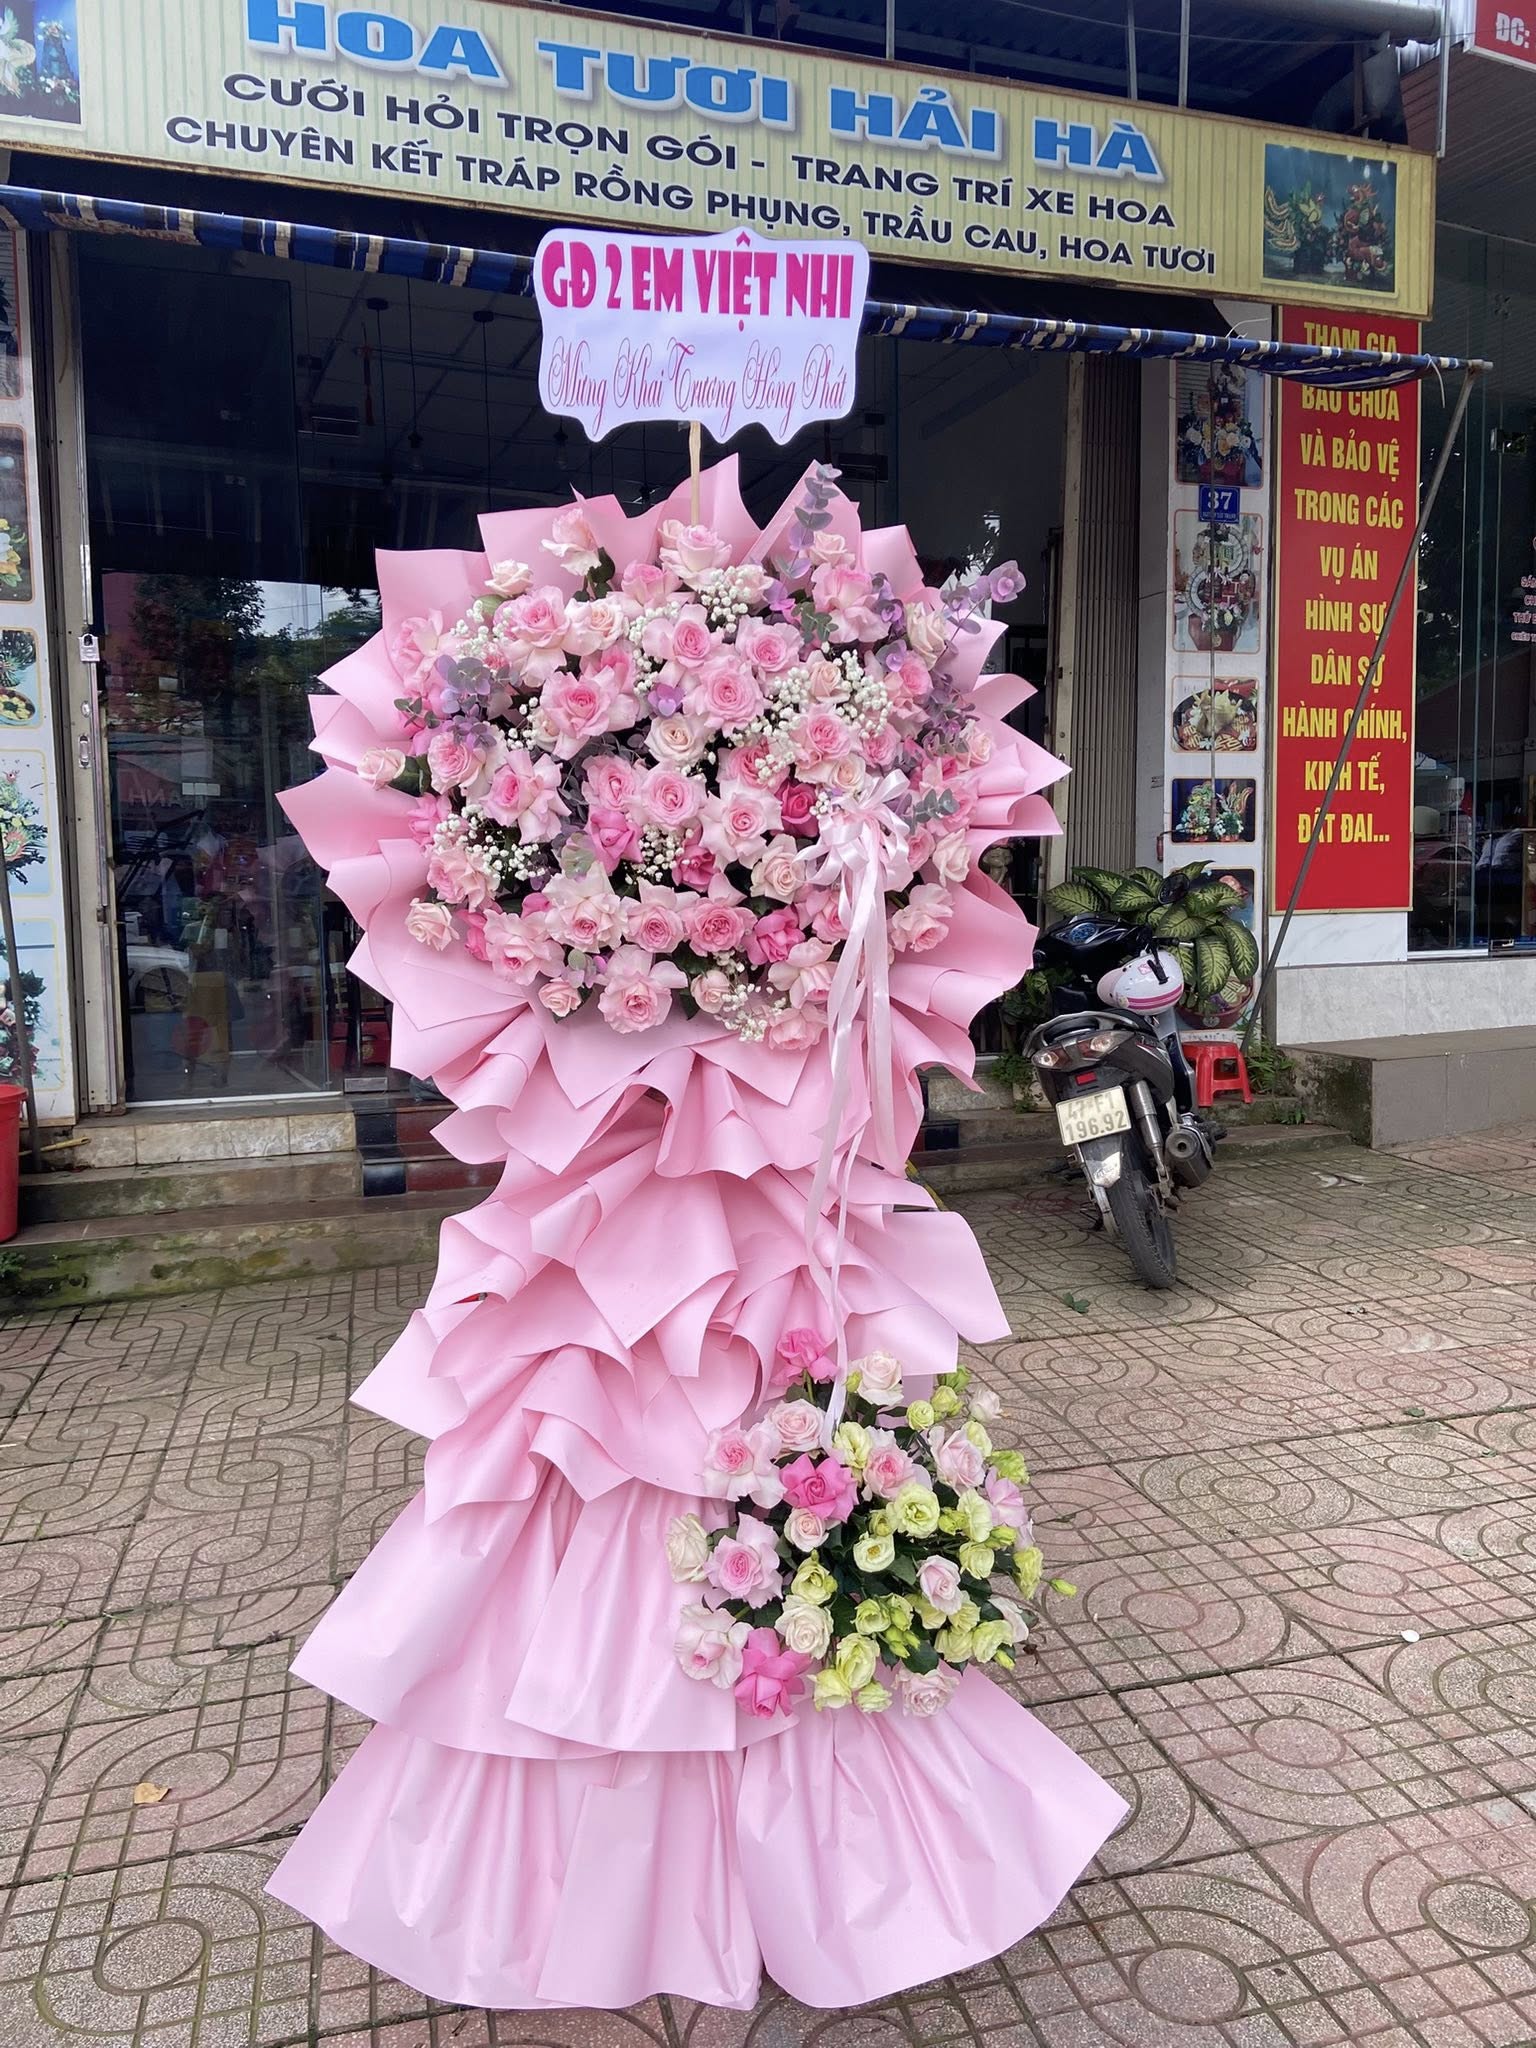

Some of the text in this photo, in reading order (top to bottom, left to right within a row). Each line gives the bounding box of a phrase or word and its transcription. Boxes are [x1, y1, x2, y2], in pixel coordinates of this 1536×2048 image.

[1495, 11, 1530, 49] ĐC:
[247, 0, 1159, 176] HOA TƯƠI HẢI HÀ
[223, 73, 1176, 228] CƯỚI HỎI TRỌN GÓI - TRANG TRÍ XE HOA
[165, 115, 1216, 275] CHUYÊN KẾT TRÁP RỒNG PHỤNG, TRẦU CAU, HOA TƯƠI
[541, 230, 855, 333] GĐ 2 EM VIỆT NHI
[547, 335, 608, 438] Mừng
[613, 337, 665, 411] Khai
[667, 336, 737, 438] Trương
[801, 343, 848, 410] Phát
[1300, 428, 1400, 483] VÀ BẢO VỆ
[1207, 491, 1233, 511] 37
[1294, 487, 1404, 530] TRONG CÁC
[1319, 542, 1379, 585] VỤ ÁN
[1305, 593, 1353, 633] HÌNH
[1311, 647, 1386, 693] DÂN SỰ
[1282, 700, 1408, 744] HÀNH CHÍNH,
[1304, 751, 1386, 796] KINH TẾ,
[1340, 812, 1391, 844] ĐAI...
[1065, 1110, 1128, 1142] 196.92
